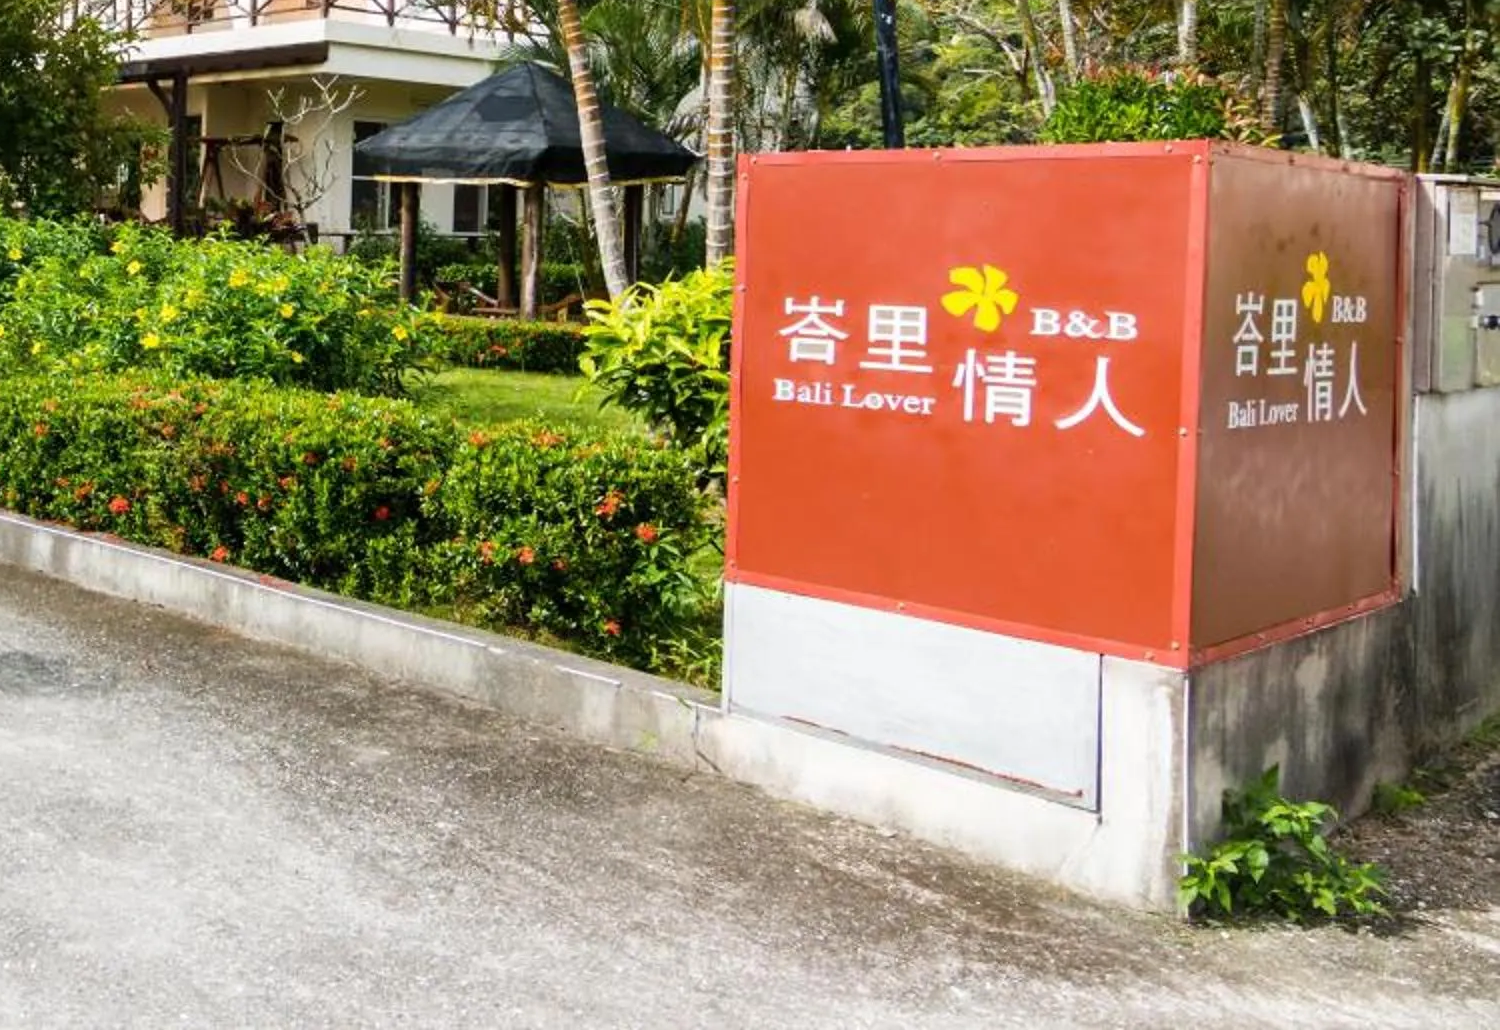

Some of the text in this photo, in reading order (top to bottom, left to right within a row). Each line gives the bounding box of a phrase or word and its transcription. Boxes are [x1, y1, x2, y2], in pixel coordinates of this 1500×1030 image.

[1029, 307, 1139, 341] B&B
[1331, 295, 1367, 323] B&B
[778, 295, 1146, 438] 峇里 情人
[1303, 340, 1368, 424] 情人
[772, 377, 936, 416] Bali Lover
[1227, 398, 1299, 430] Bali Lover
